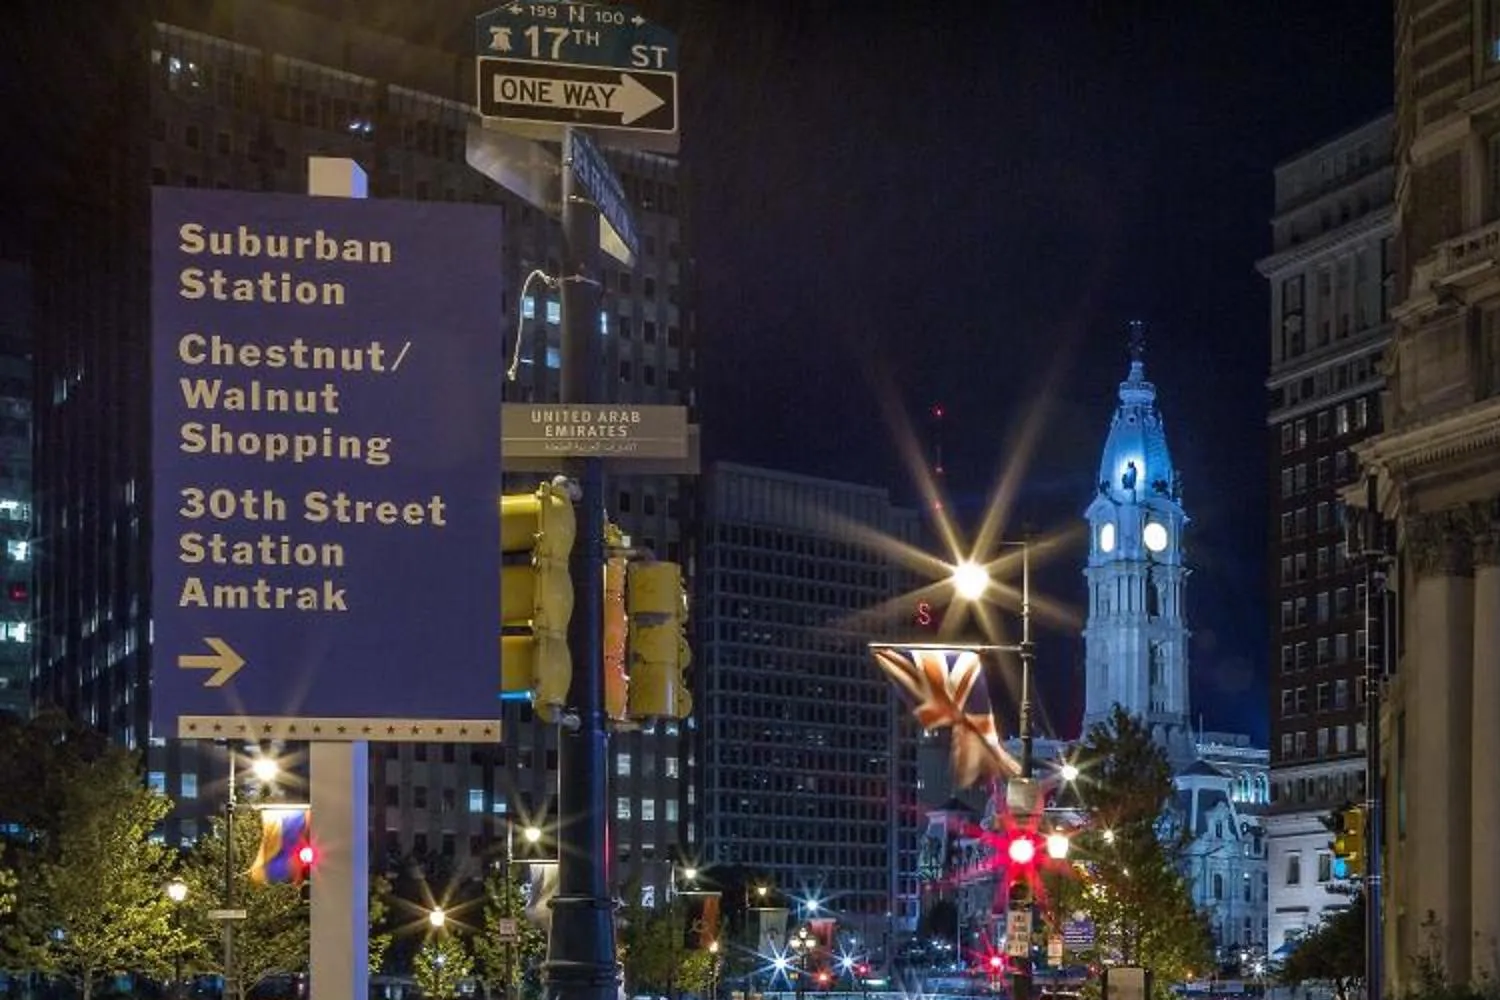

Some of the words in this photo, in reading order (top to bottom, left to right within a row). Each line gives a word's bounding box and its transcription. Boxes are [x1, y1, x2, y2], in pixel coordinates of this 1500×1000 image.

[530, 5, 557, 19] 199
[569, 5, 585, 23] N
[595, 11, 625, 25] 100
[524, 25, 600, 60] 17TH
[632, 45, 668, 69] ST
[501, 78, 552, 103] ONE
[563, 83, 617, 108] WAY
[179, 222, 392, 263] Suburban
[179, 267, 346, 305] Station
[178, 333, 412, 372] Chestnut/
[179, 377, 340, 414] Walnut
[531, 410, 592, 423] UNITED
[597, 411, 642, 423] ARAB
[545, 425, 628, 437] EMIRATES
[179, 421, 392, 466] Shopping
[179, 486, 287, 521] 30th
[304, 490, 447, 527] Street
[179, 532, 345, 567] Station
[179, 576, 348, 611] Amtrak
